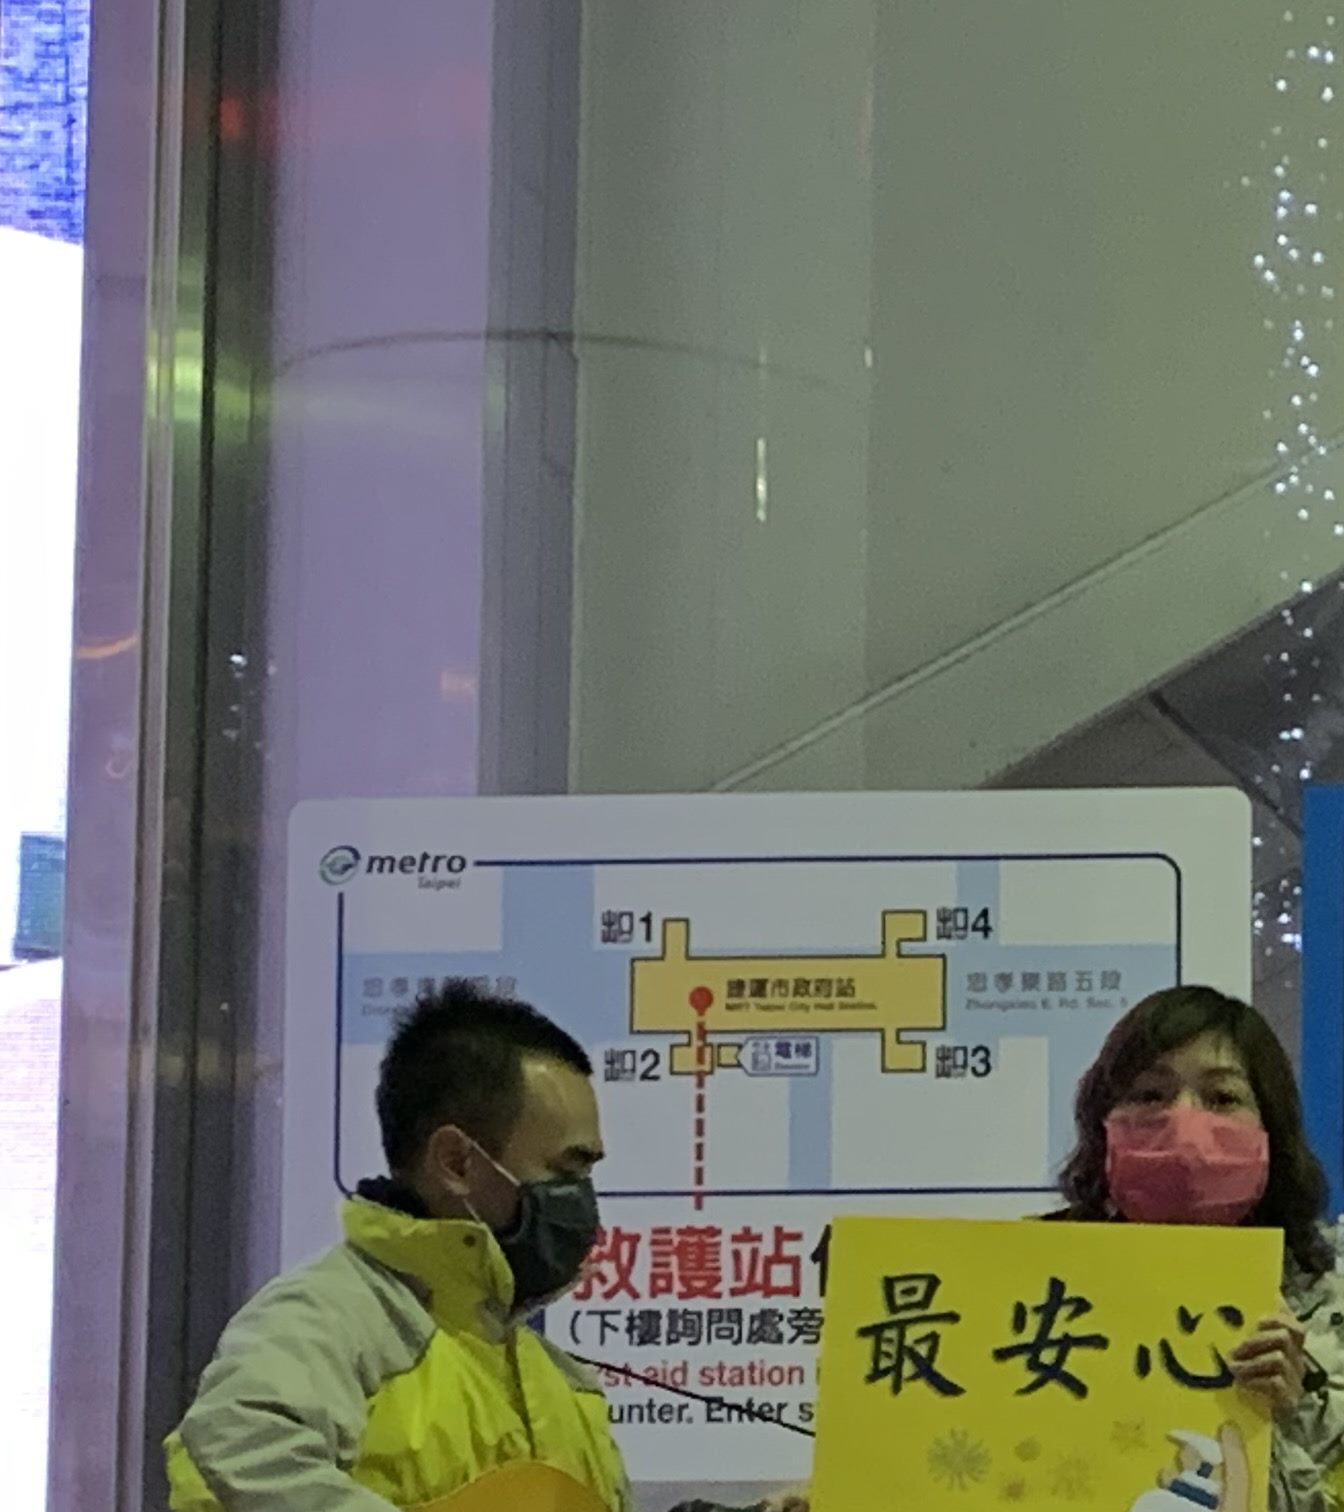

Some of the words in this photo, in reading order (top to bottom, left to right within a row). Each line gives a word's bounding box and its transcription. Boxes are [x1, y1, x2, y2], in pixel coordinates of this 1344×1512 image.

[366, 852, 466, 875] metro
[573, 1224, 832, 1300] 救護站
[857, 1272, 1244, 1400] 最安心
[644, 1361, 688, 1387] aid
[698, 1361, 805, 1388] station
[705, 1399, 788, 1424] Enter
